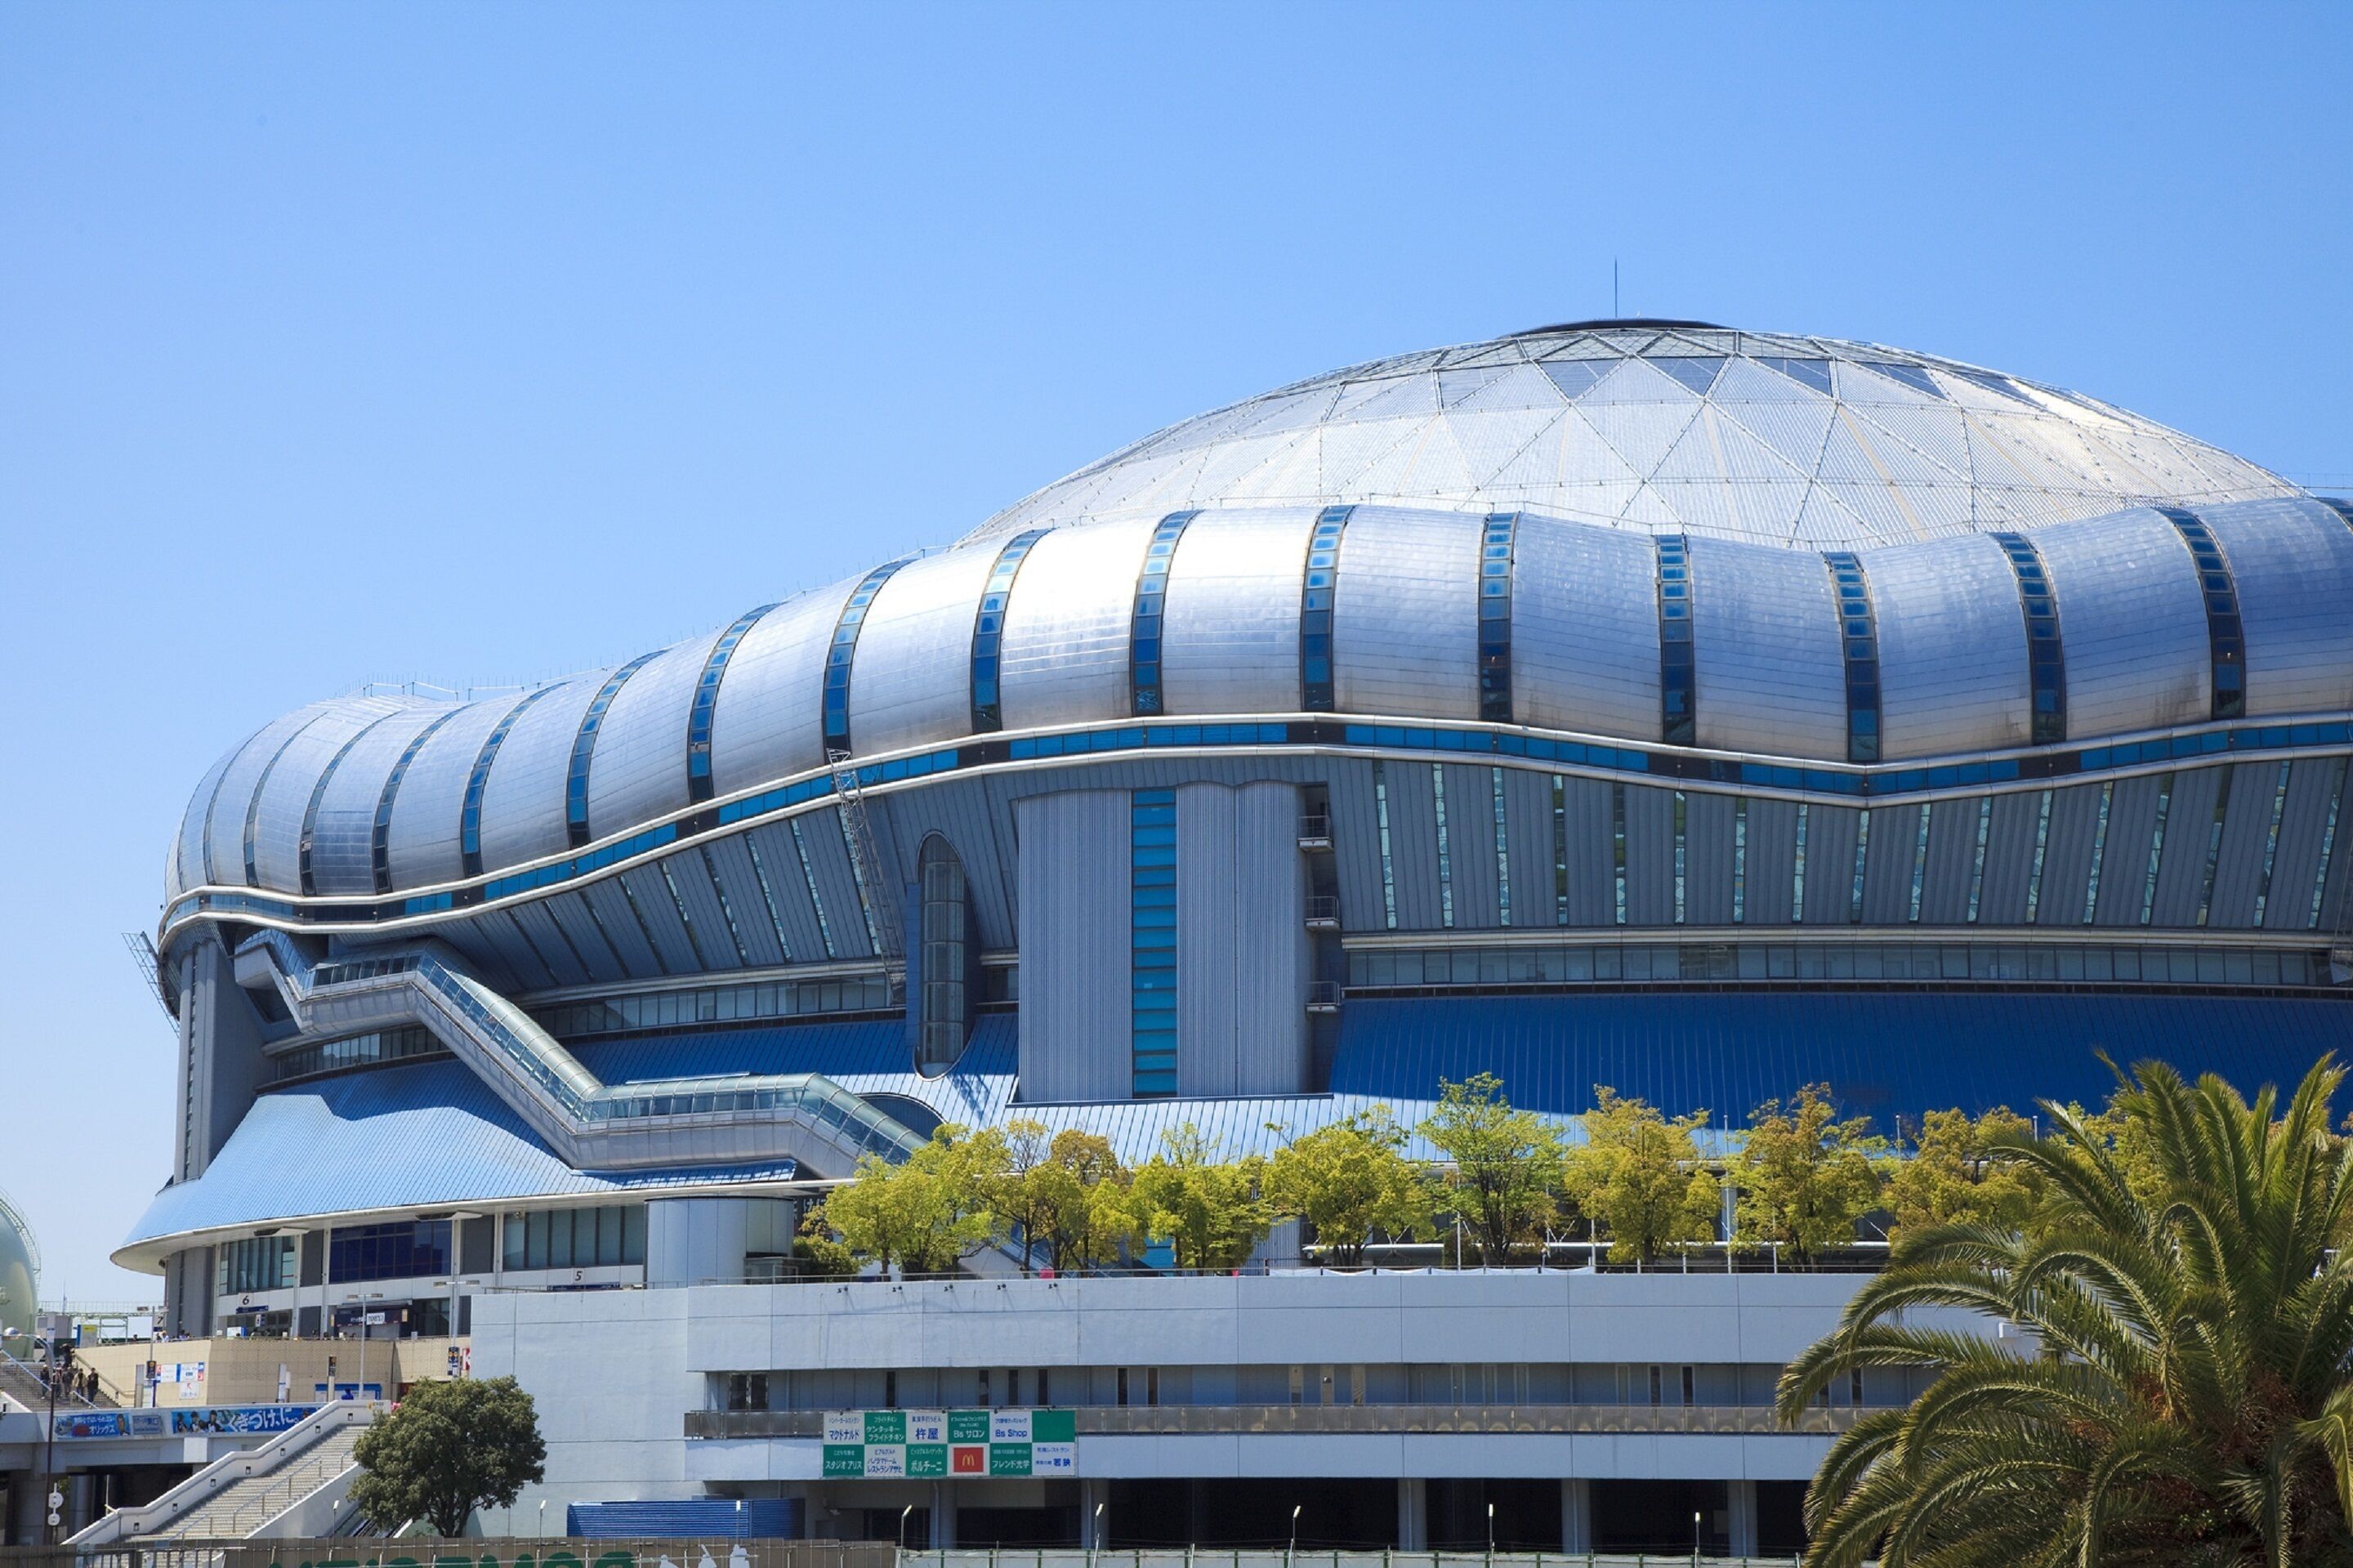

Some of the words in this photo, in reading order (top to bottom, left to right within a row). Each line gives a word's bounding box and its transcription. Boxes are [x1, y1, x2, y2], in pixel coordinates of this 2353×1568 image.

[575, 1271, 583, 1281] 5
[242, 1295, 250, 1305] 6
[157, 1316, 164, 1325] 7
[89, 1425, 116, 1434] オリックス
[915, 1427, 939, 1440] 杵屋
[953, 1430, 964, 1438] Bs
[966, 1430, 985, 1438] サロン
[995, 1429, 1006, 1437] Bs
[1007, 1429, 1028, 1438] Shop
[828, 1429, 859, 1441] マクドナルド
[868, 1434, 904, 1442] フライドチキン
[993, 1460, 1030, 1469] フレンド光学
